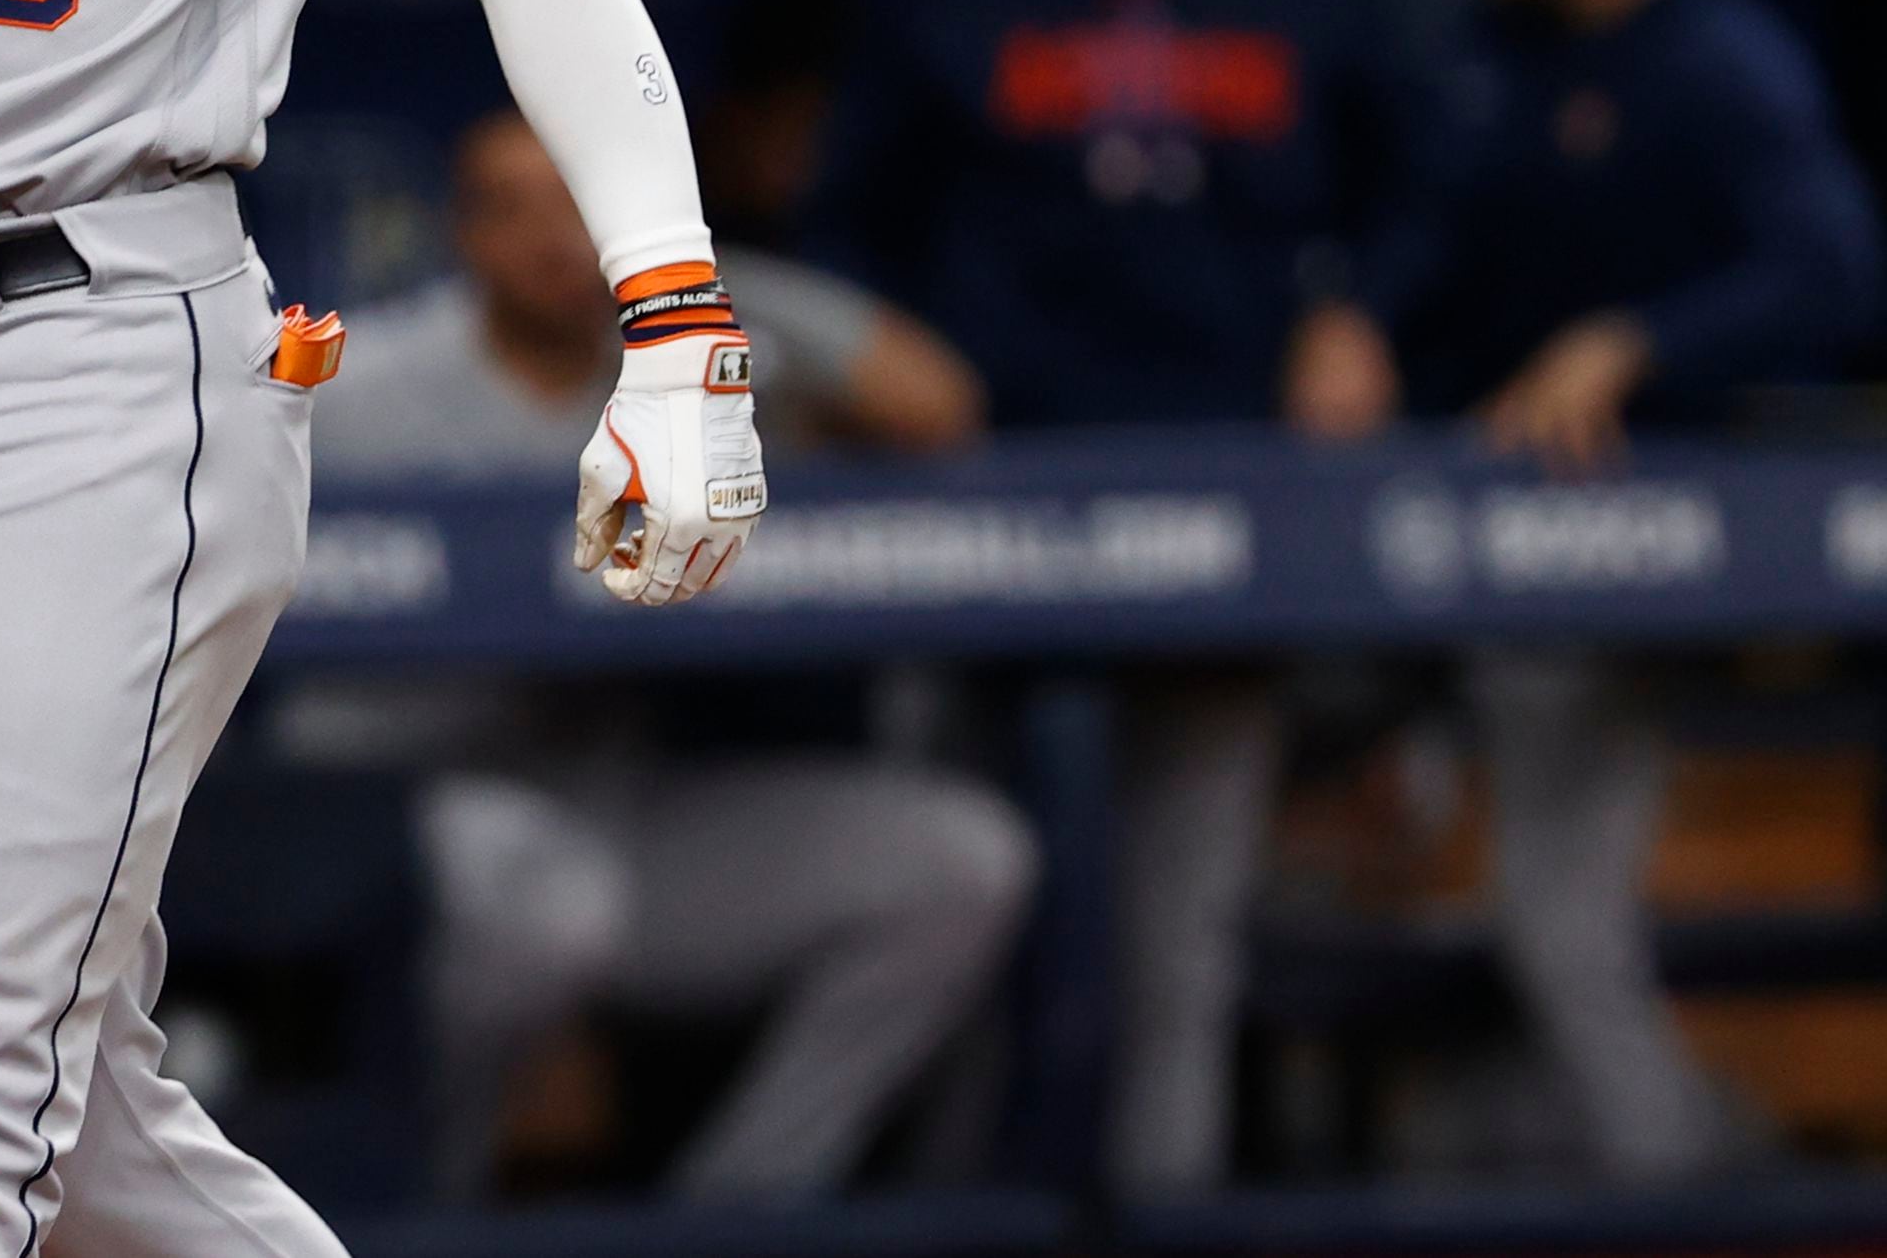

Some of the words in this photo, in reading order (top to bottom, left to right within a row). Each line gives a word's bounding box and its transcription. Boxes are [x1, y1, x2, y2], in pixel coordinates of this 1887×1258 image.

[636, 53, 668, 105] 3
[634, 294, 681, 317] FIGHTS
[681, 291, 719, 306] ALONE
